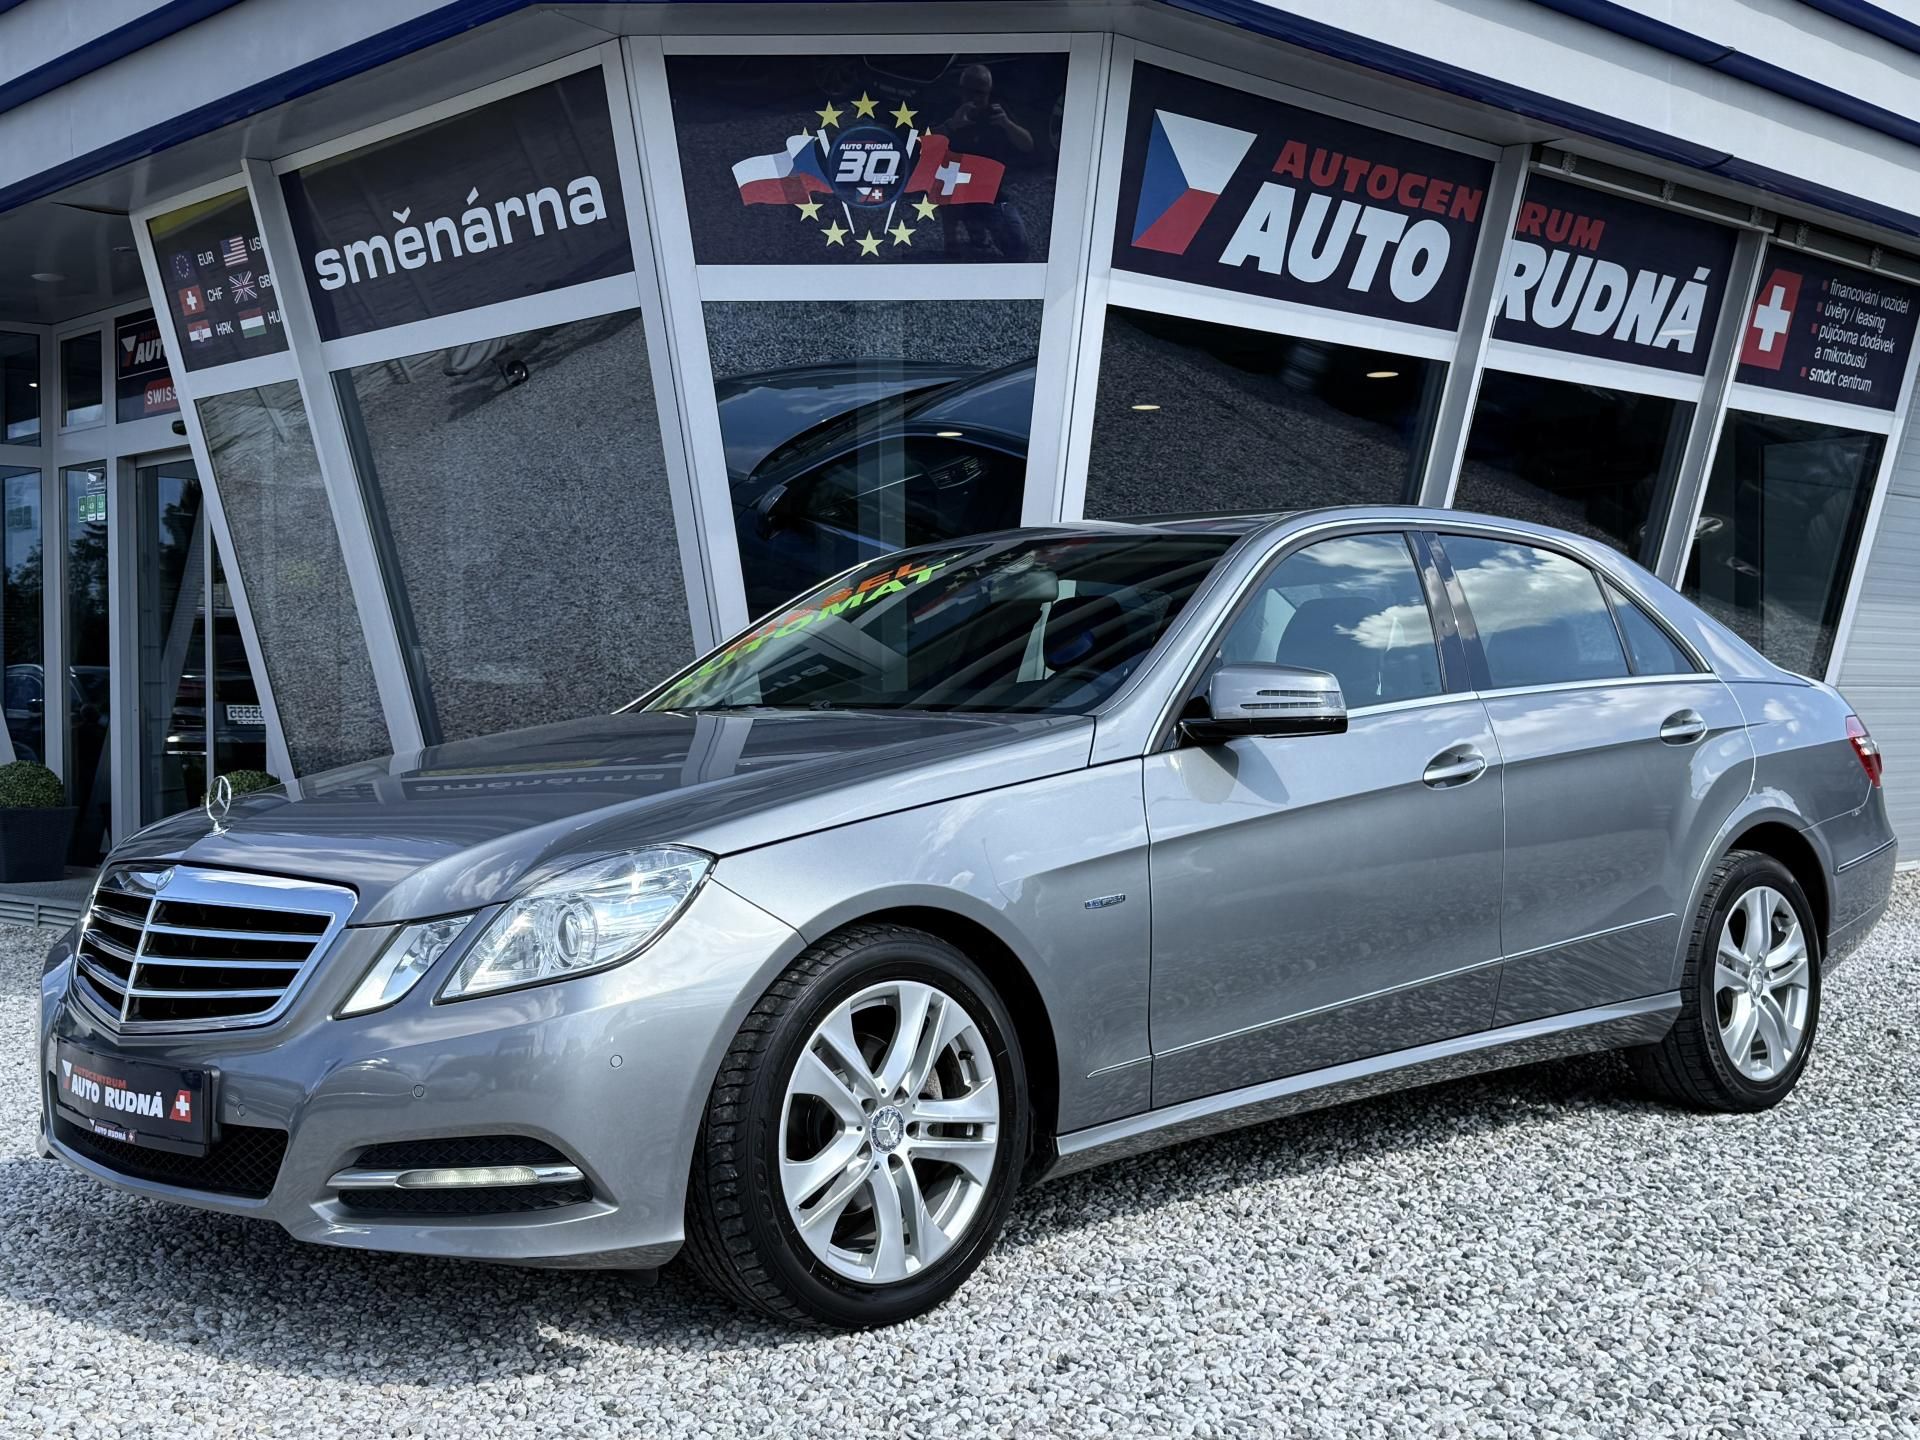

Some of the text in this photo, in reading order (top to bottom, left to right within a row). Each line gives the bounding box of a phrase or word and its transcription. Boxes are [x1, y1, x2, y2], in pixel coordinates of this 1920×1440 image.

[835, 151, 901, 182] 30
[314, 175, 607, 291] směnárna
[249, 237, 263, 251] US
[197, 251, 215, 266] EUR
[1218, 181, 1711, 354] AUTO RUDNÁ
[258, 274, 273, 288] GB
[207, 287, 223, 302] CHF
[1830, 279, 1910, 314] financování vozidel
[267, 310, 282, 325] HU
[1825, 300, 1850, 324] úvěry
[1855, 308, 1886, 333] leasing
[216, 321, 234, 336] HRK
[134, 338, 167, 365] AUT
[1860, 332, 1895, 354] dodávek
[1814, 347, 1822, 359] a
[1838, 374, 1872, 392] centrum
[147, 386, 178, 405] SWISS
[71, 1074, 164, 1118] AUTO RUDNÁ
